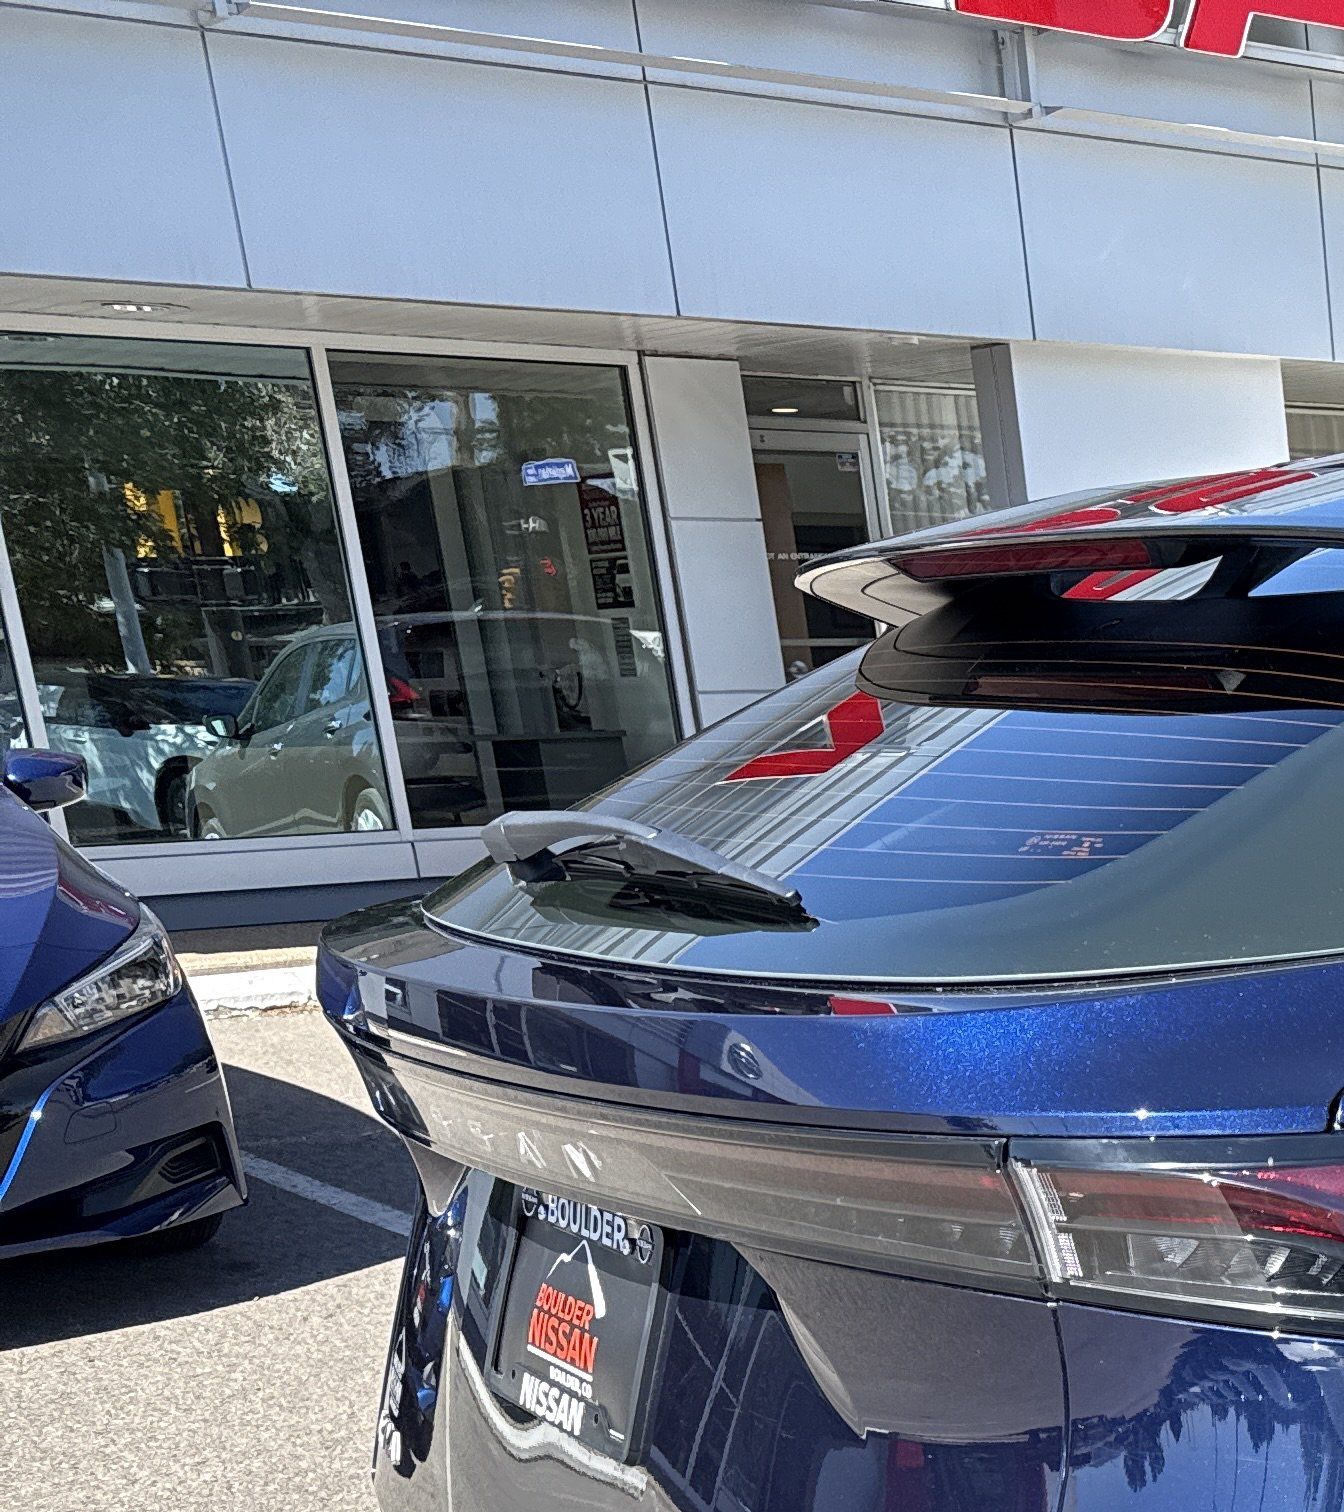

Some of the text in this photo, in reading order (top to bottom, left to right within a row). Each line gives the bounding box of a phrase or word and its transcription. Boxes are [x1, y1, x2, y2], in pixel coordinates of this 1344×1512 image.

[547, 1194, 627, 1252] BOULDER
[535, 1282, 595, 1331] BOULDER
[527, 1308, 599, 1374] NISSAN
[519, 1371, 587, 1436] NISSAN
